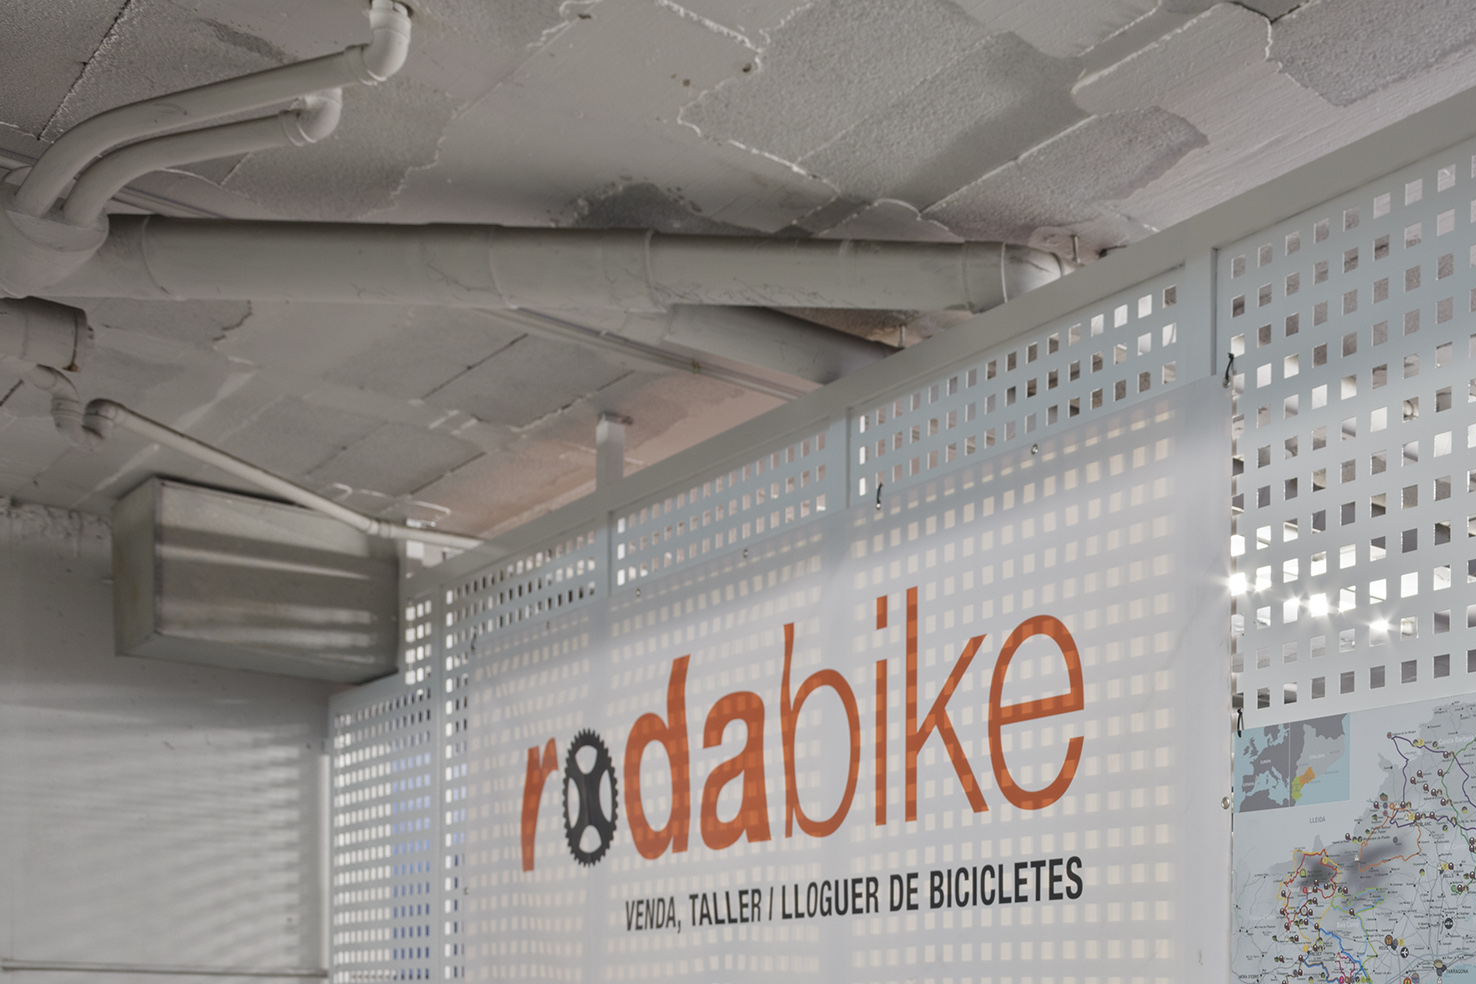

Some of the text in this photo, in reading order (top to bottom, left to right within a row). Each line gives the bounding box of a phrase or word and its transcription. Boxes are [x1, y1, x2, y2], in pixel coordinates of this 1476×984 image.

[521, 586, 1085, 872] rodabike
[1309, 816, 1326, 824] LLEIDA
[625, 898, 682, 934] VENDA,
[689, 888, 762, 927] TALLER
[781, 876, 880, 919] LLOGUER
[889, 872, 920, 912] DE
[929, 855, 1083, 910] BICICLETES
